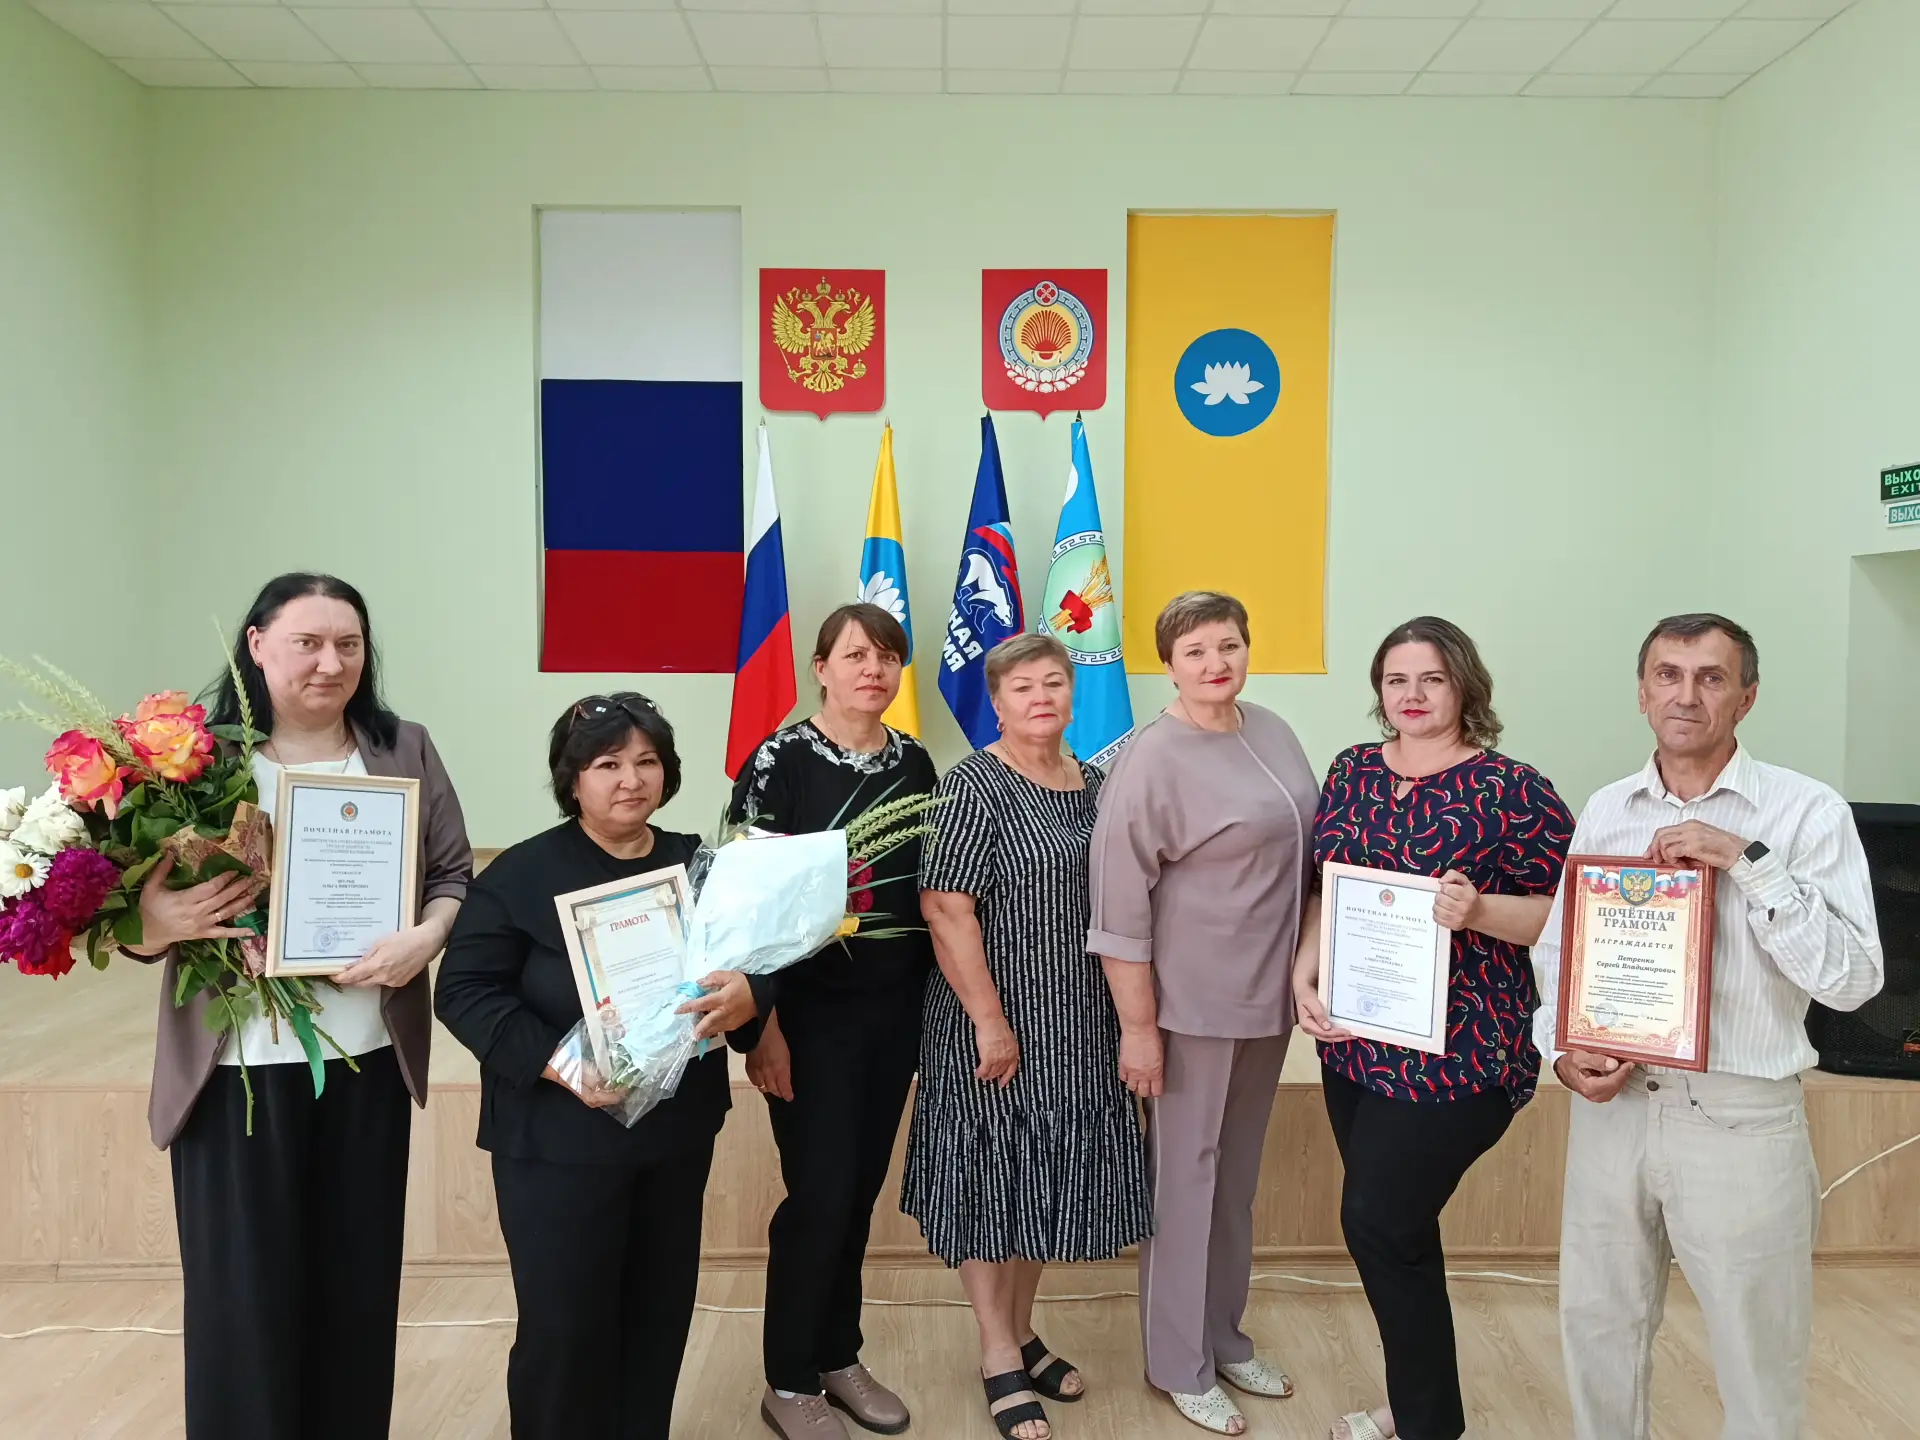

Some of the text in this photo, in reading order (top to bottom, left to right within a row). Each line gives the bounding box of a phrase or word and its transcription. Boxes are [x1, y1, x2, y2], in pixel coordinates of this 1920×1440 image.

[949, 603, 984, 661] НАЯ
[943, 631, 966, 673] ИЯ
[353, 828, 392, 836] ГРАМОТА
[1597, 906, 1676, 921] ПОЧЁТНАЯ
[609, 913, 650, 932] ГРАМОТА
[1603, 917, 1667, 931] ГРАМОТА
[1594, 937, 1674, 950] НАГРАЖДАЕТСЯ
[1617, 954, 1655, 964] Петренко
[1596, 960, 1676, 974] Сергей Владимирович
